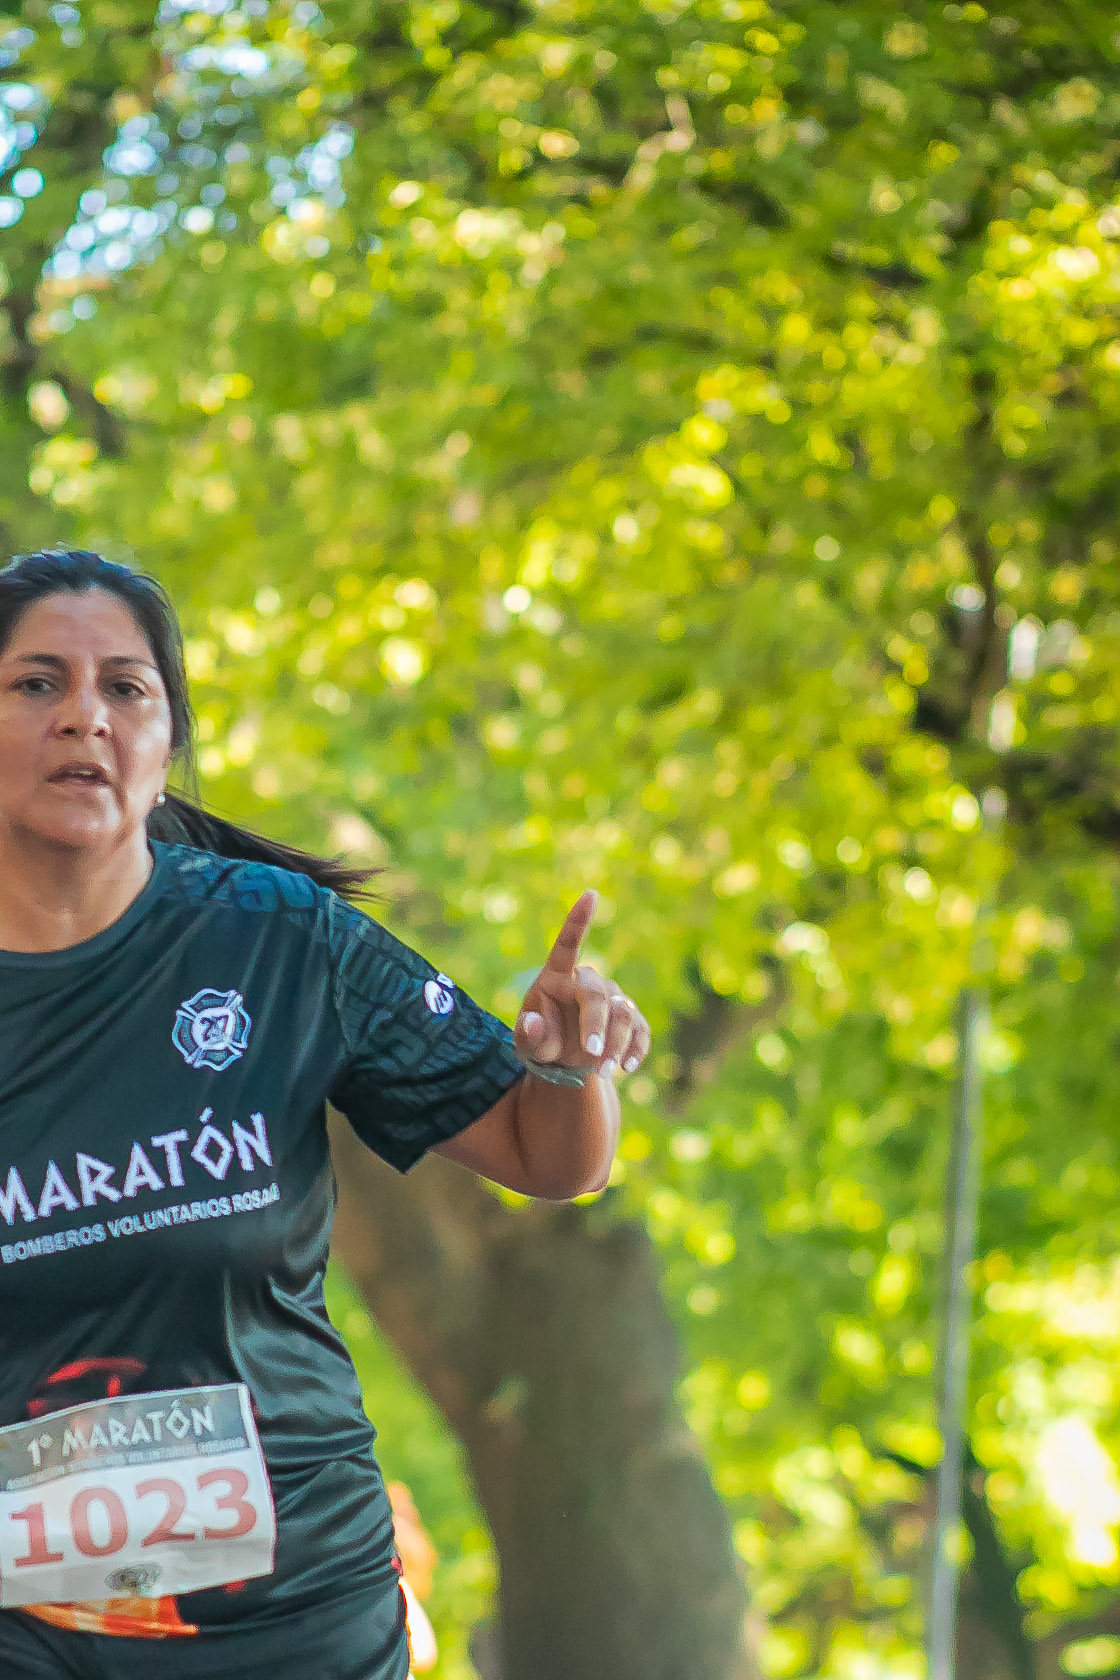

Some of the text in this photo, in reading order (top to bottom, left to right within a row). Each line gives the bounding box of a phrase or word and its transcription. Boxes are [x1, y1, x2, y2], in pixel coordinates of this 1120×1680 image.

[0, 1223, 106, 1263] BOMBEROS
[107, 1196, 231, 1238] VOLUNTARIOS
[62, 1400, 216, 1456] MARATÓN
[8, 1467, 258, 1568] 1023
